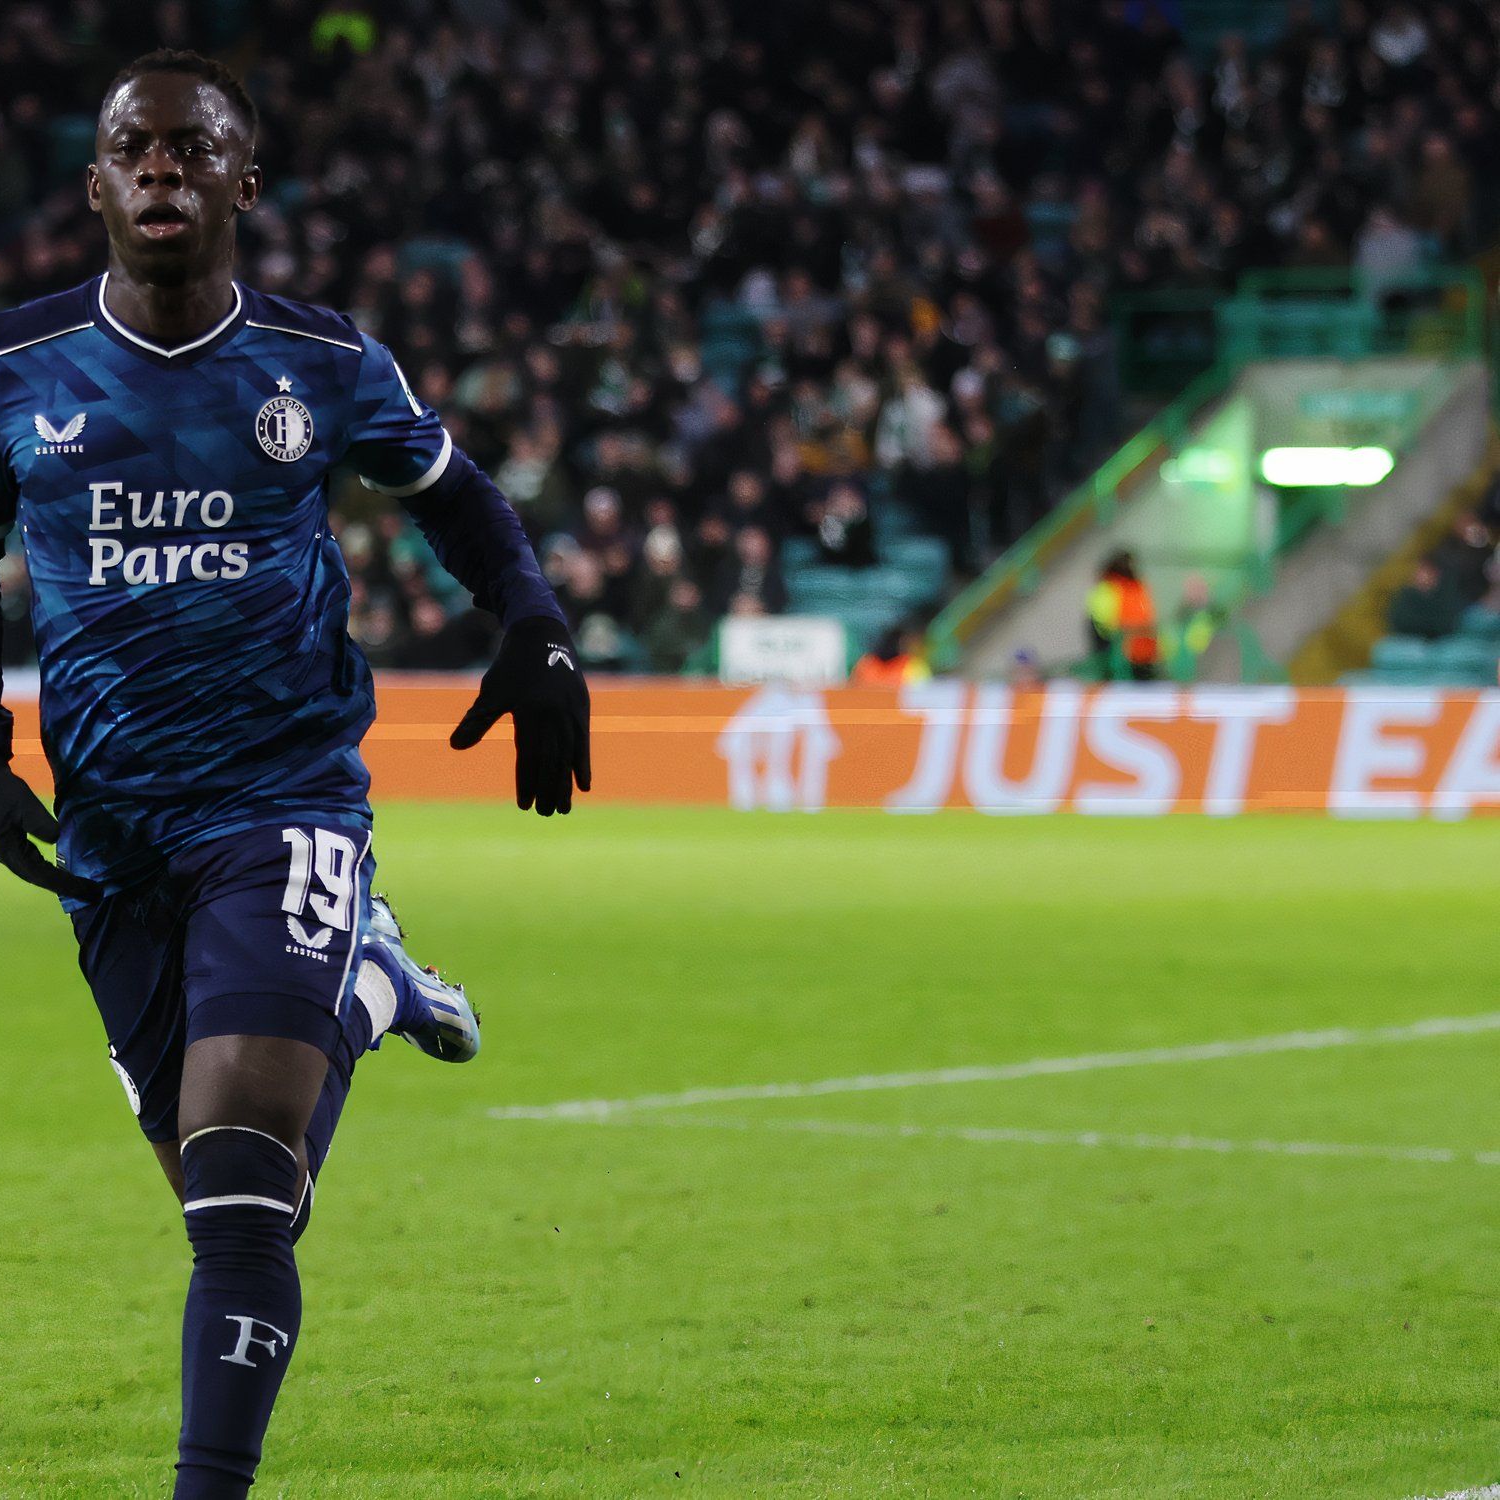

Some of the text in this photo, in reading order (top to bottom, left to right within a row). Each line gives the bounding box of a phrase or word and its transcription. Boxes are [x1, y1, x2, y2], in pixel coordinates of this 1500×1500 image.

[35, 445, 84, 455] CASTORE
[88, 481, 235, 530] Euro
[88, 538, 248, 586] Parcs
[884, 679, 1500, 822] JUST EA
[281, 827, 357, 931] 19
[219, 1315, 289, 1368] F
